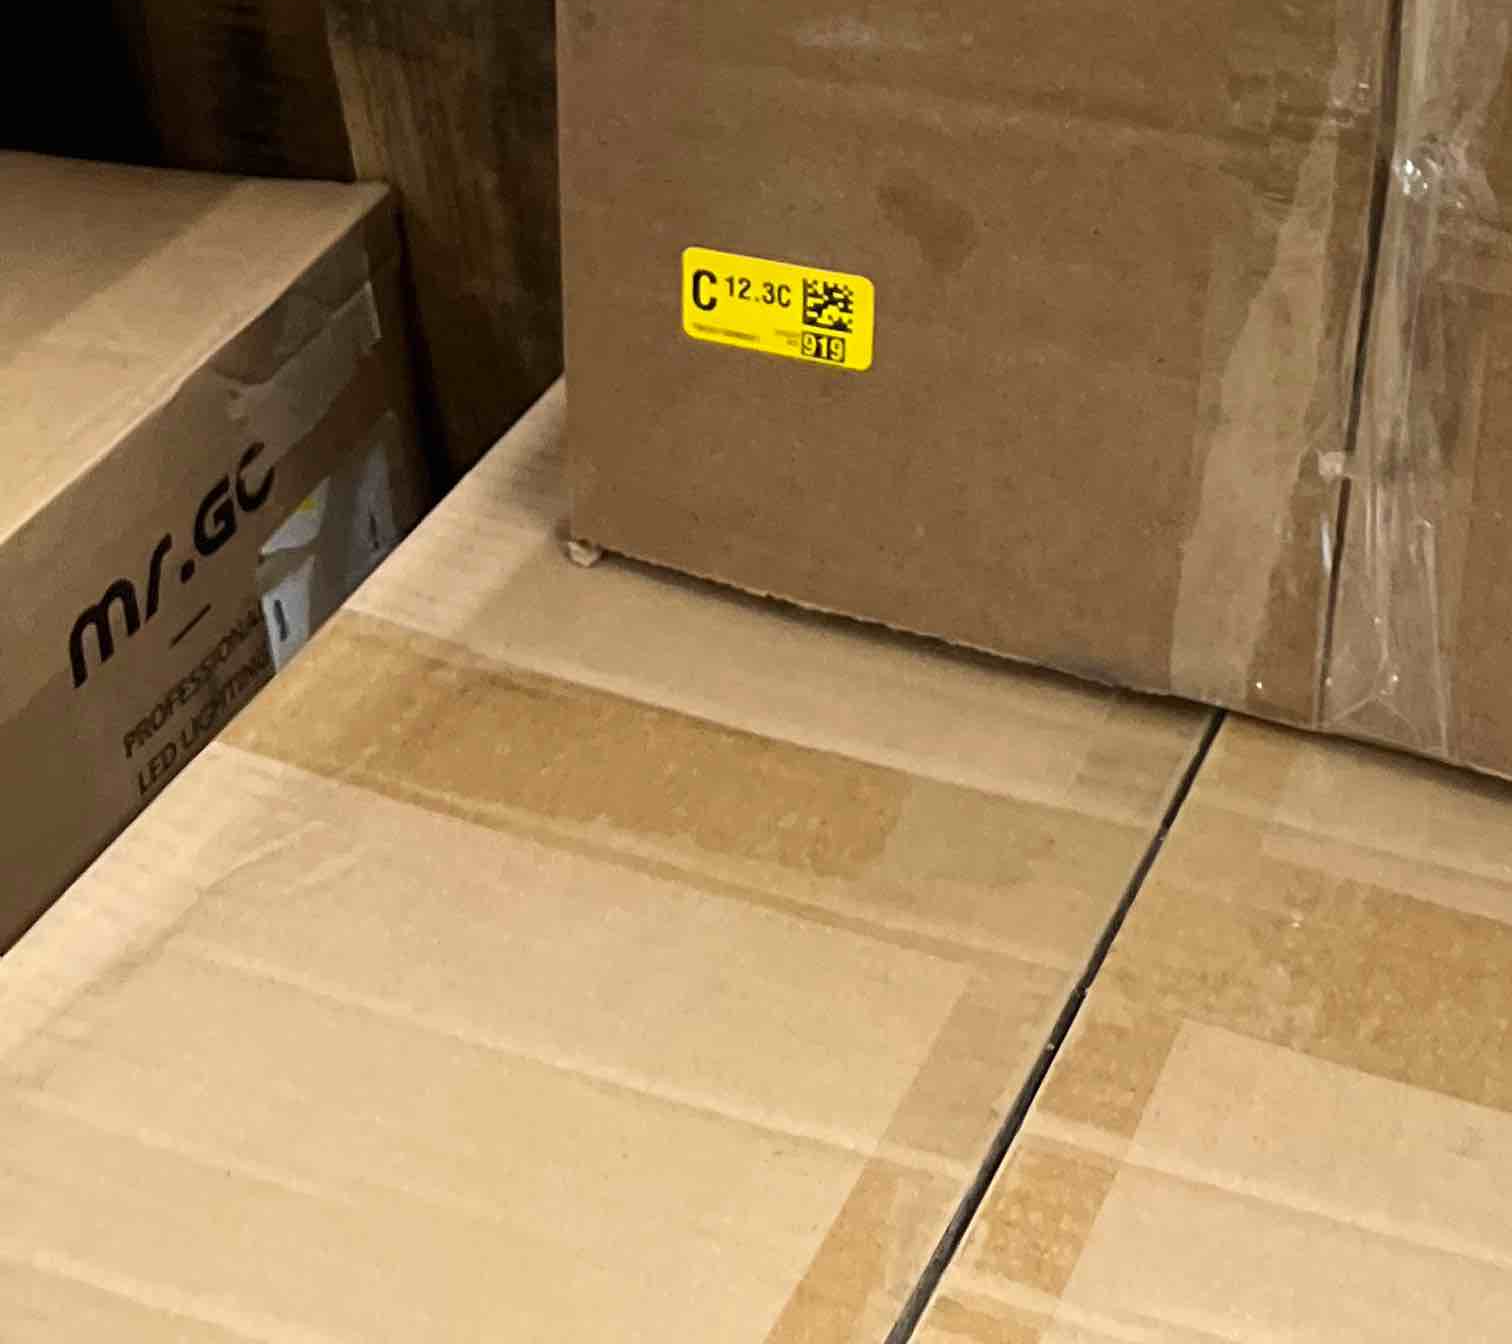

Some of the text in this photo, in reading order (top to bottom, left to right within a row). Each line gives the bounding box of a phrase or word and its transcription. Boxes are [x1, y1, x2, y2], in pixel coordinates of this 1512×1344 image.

[692, 268, 792, 311] C 12.3C
[801, 331, 846, 363] 919
[137, 741, 178, 796] LED
